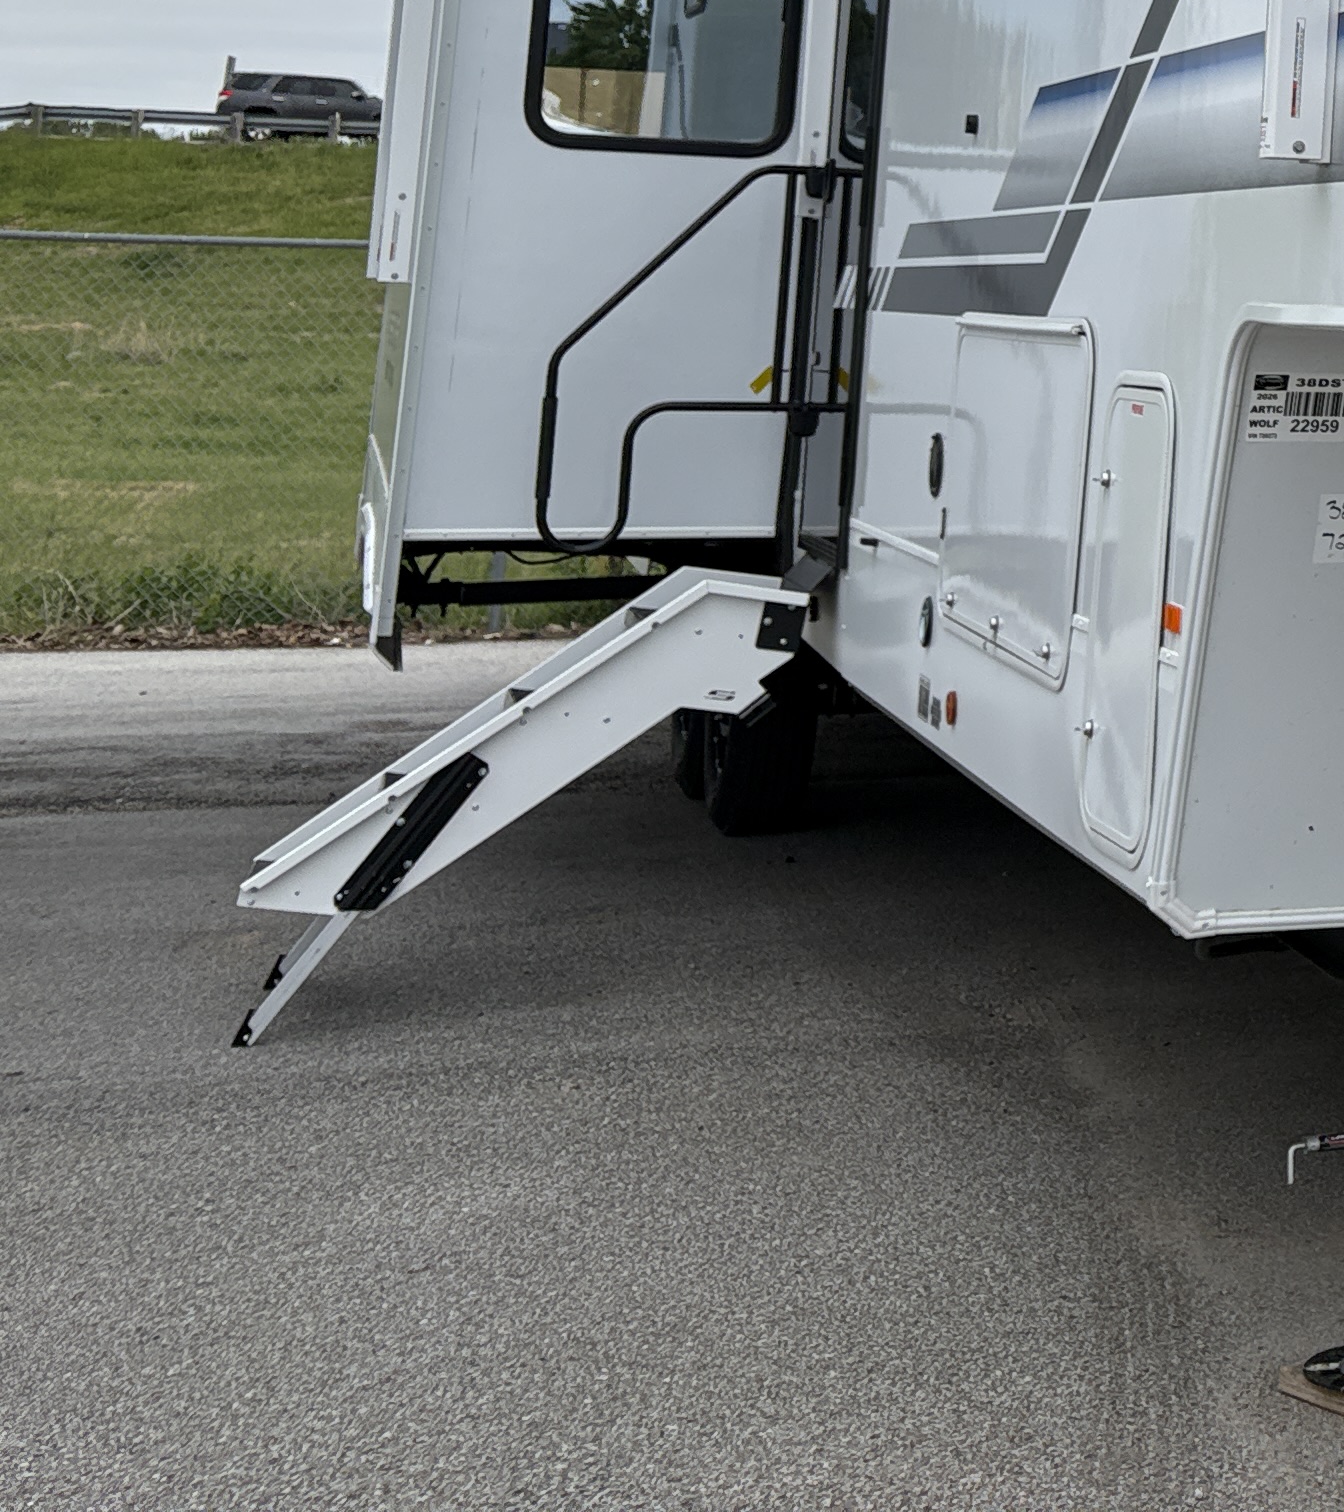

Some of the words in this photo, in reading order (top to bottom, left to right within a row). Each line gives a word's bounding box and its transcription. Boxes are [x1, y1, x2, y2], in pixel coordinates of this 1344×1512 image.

[1249, 404, 1284, 414] ARTIC
[1248, 419, 1280, 428] WOLF
[1289, 419, 1340, 433] 22959
